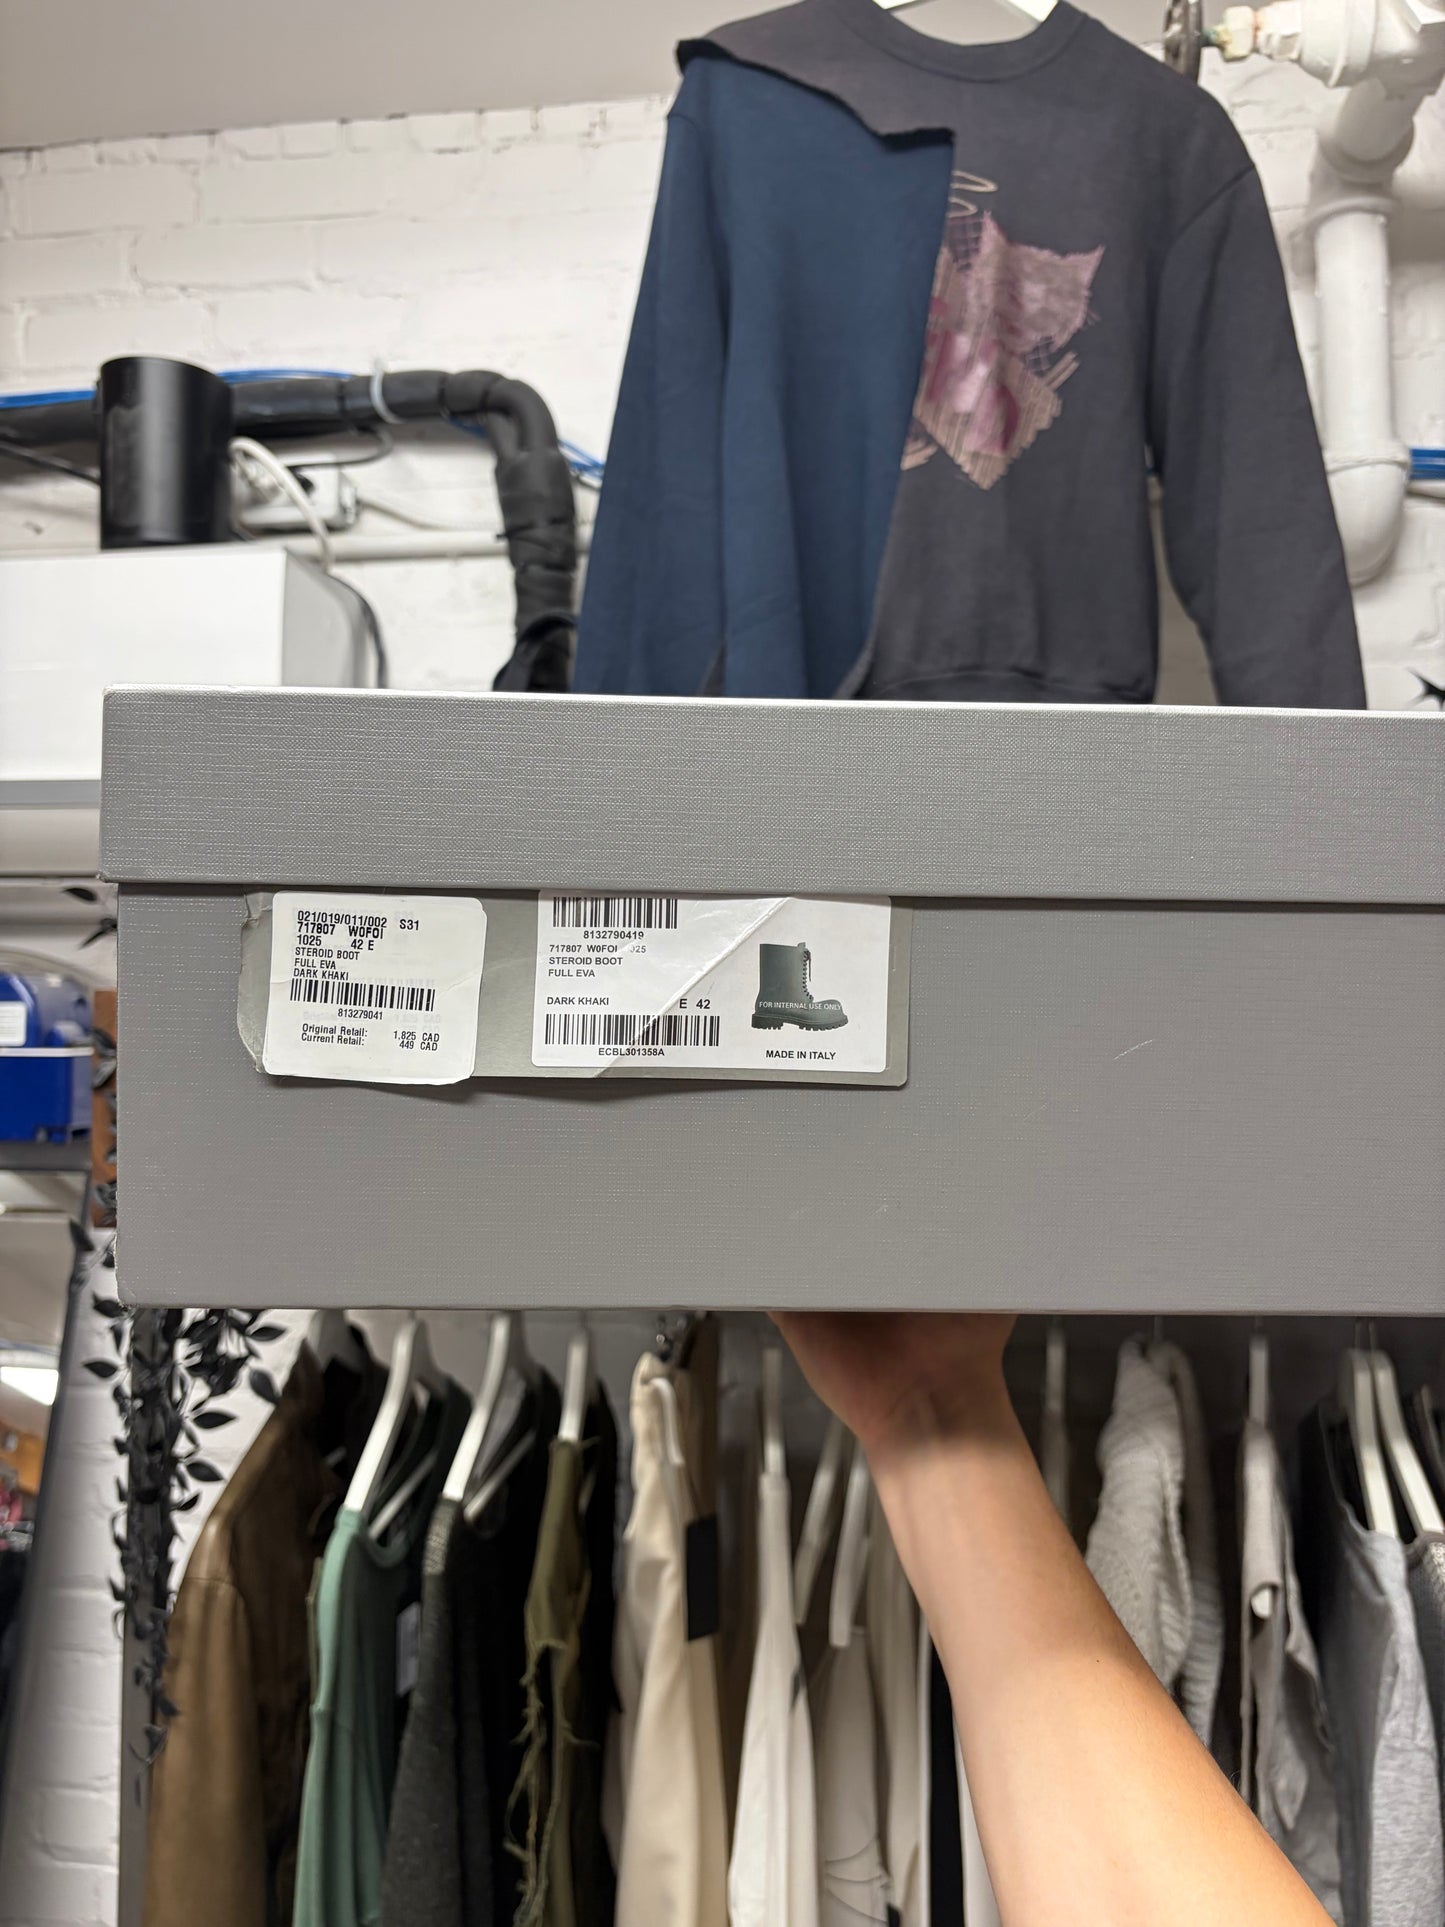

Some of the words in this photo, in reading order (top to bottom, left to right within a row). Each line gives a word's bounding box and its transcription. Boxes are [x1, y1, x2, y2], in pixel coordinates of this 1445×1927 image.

[297, 910, 388, 928] 021/019/011/002
[399, 918, 419, 931] S31
[297, 921, 336, 936] 717807
[583, 930, 644, 940] 8132790419
[297, 934, 321, 946] 1025
[350, 938, 363, 950] 42
[367, 940, 375, 951] E
[295, 946, 333, 959] STEROID
[336, 949, 360, 960] BOOT
[549, 944, 582, 953] 717807
[294, 957, 317, 968] FULL
[320, 960, 336, 970] EVA
[548, 956, 592, 965] STEROID
[595, 957, 623, 965] BOOT
[293, 967, 318, 979] DARK
[321, 970, 349, 981] KHAKI
[548, 969, 573, 977] FULL
[576, 969, 596, 977] EVA
[546, 996, 576, 1005] DARK
[578, 997, 609, 1006] KHAKI
[679, 999, 688, 1009] E
[695, 999, 711, 1010] 42
[823, 1003, 841, 1011] ONLY
[337, 1008, 383, 1020] 813279041
[302, 1023, 337, 1035] Original
[340, 1025, 368, 1037] Retail:
[422, 1032, 440, 1042] CAD
[301, 1032, 334, 1044] Current
[337, 1035, 365, 1046] Retail:
[399, 1039, 415, 1050] 449
[420, 1041, 438, 1051] CAD
[598, 1047, 665, 1057] ECBL301358A
[765, 1050, 794, 1059] MADE
[797, 1051, 806, 1059] IN
[809, 1051, 836, 1060] ITALY
